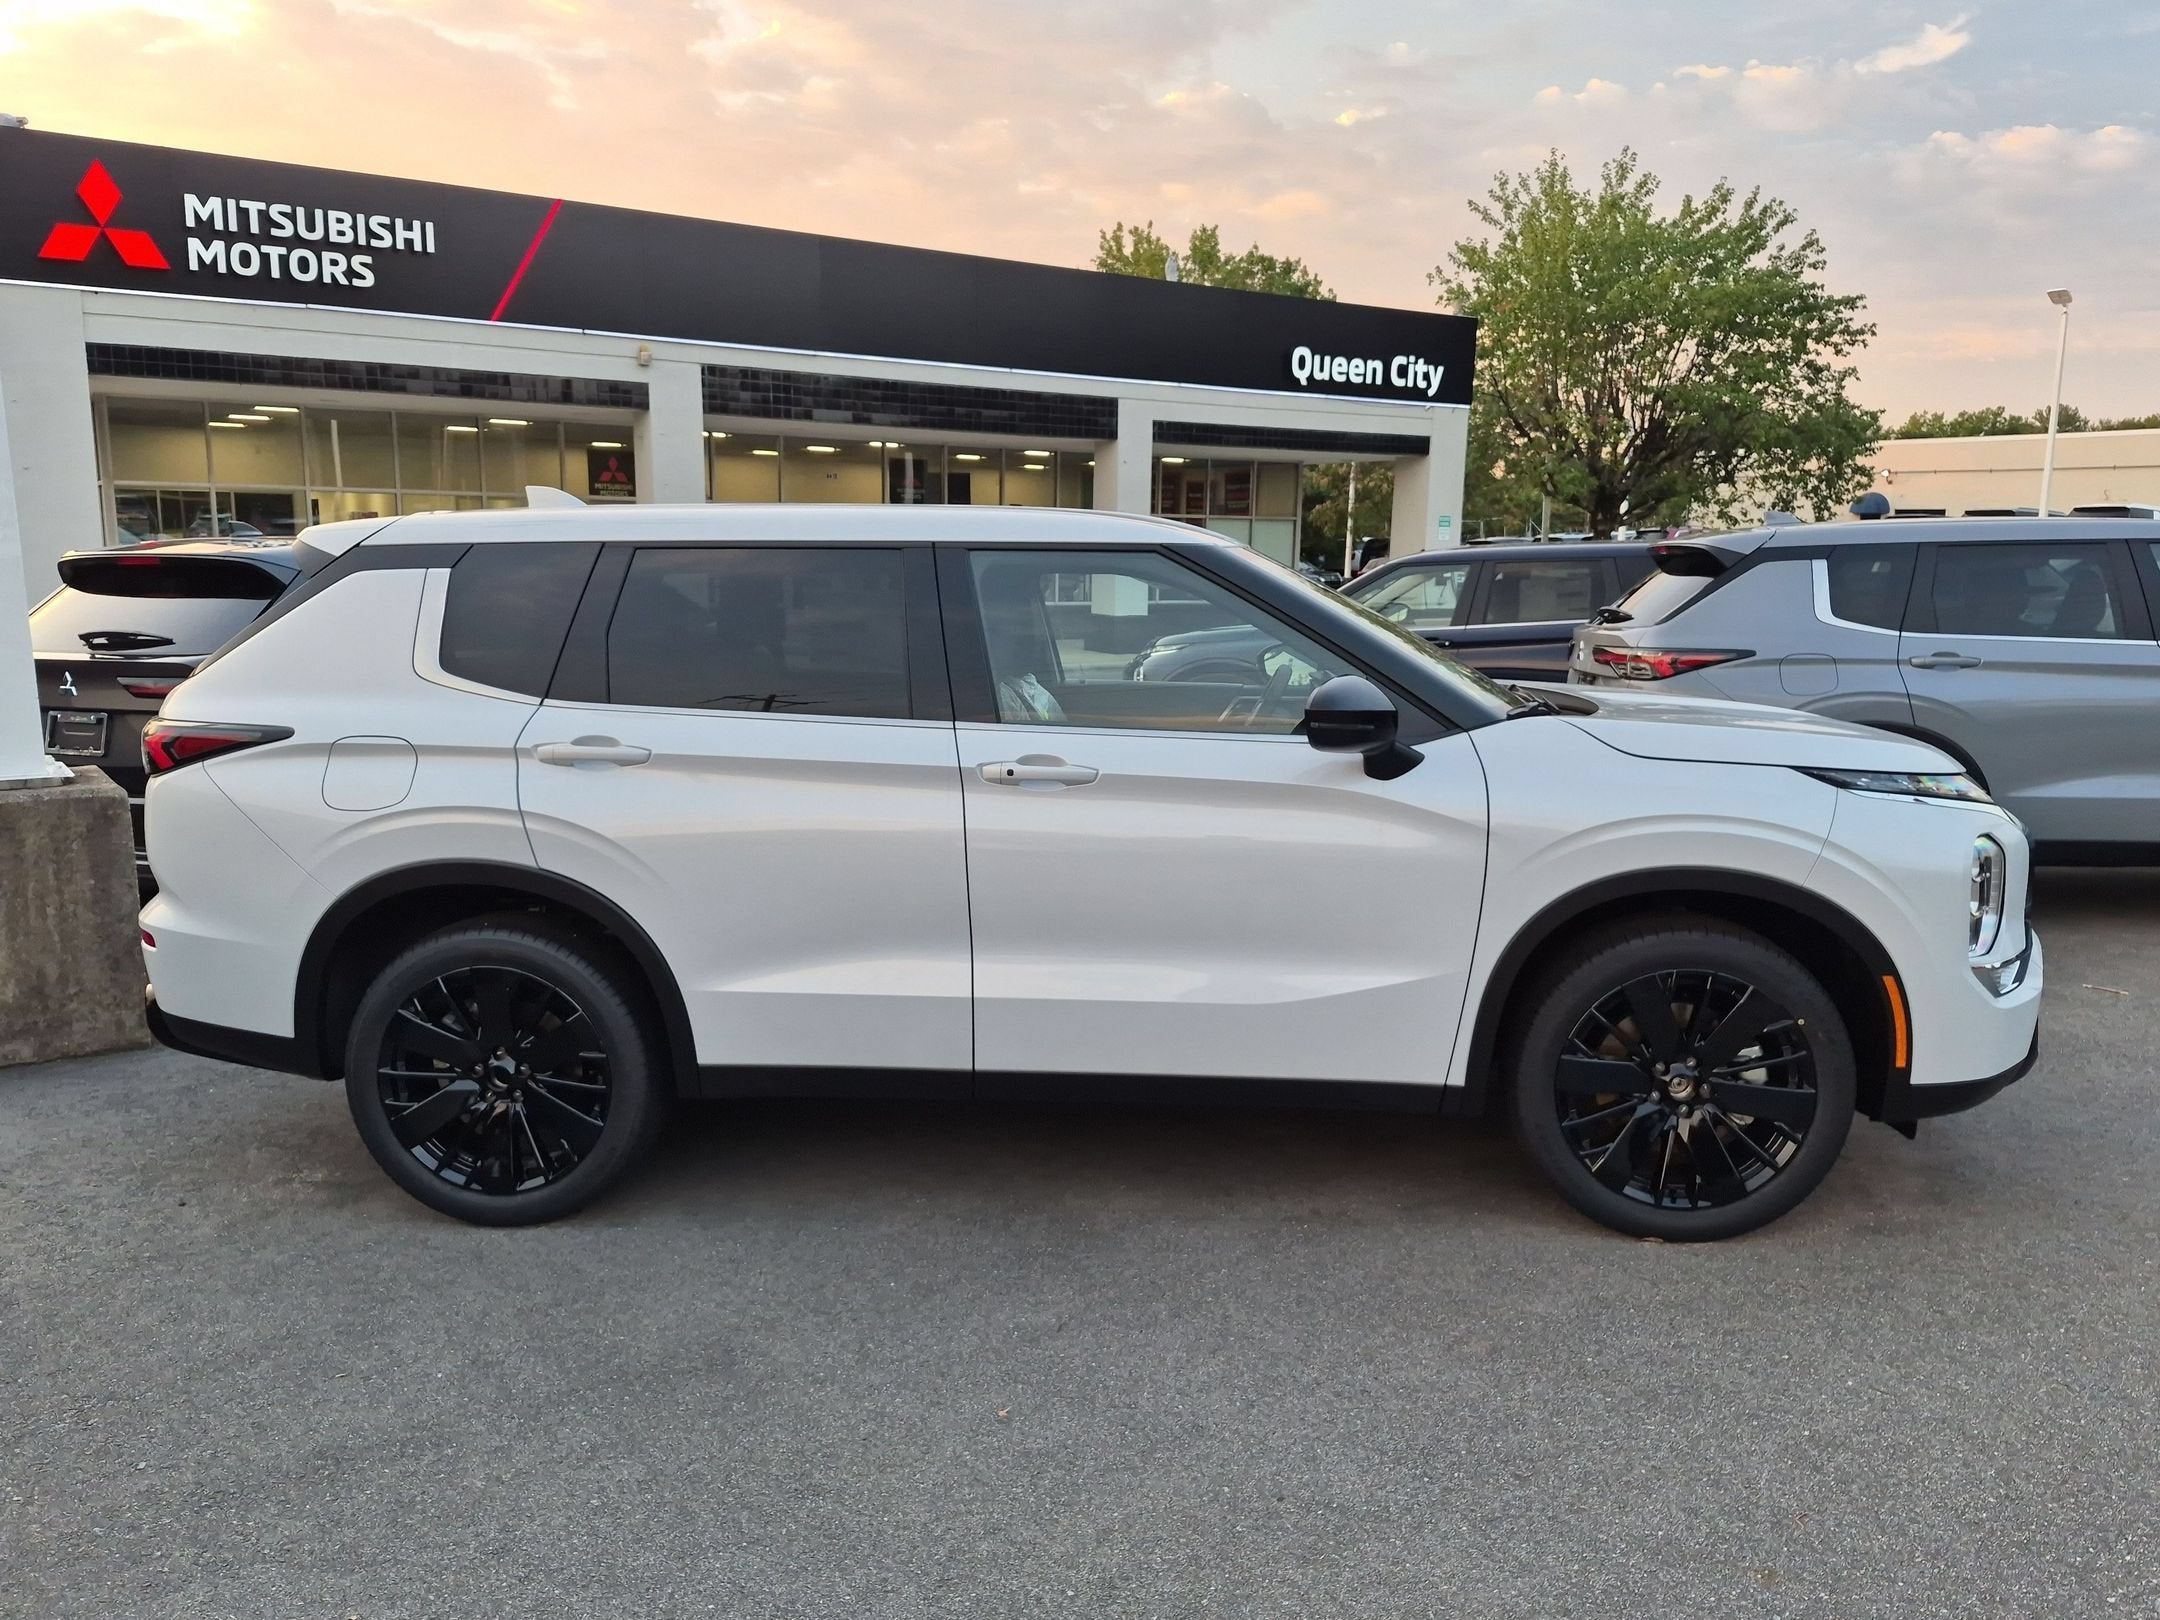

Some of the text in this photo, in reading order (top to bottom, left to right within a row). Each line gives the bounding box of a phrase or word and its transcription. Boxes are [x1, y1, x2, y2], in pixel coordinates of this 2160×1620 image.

[184, 193, 435, 254] MITSUBISHI
[187, 237, 375, 288] MOTORS
[1291, 345, 1444, 397] Queen City
